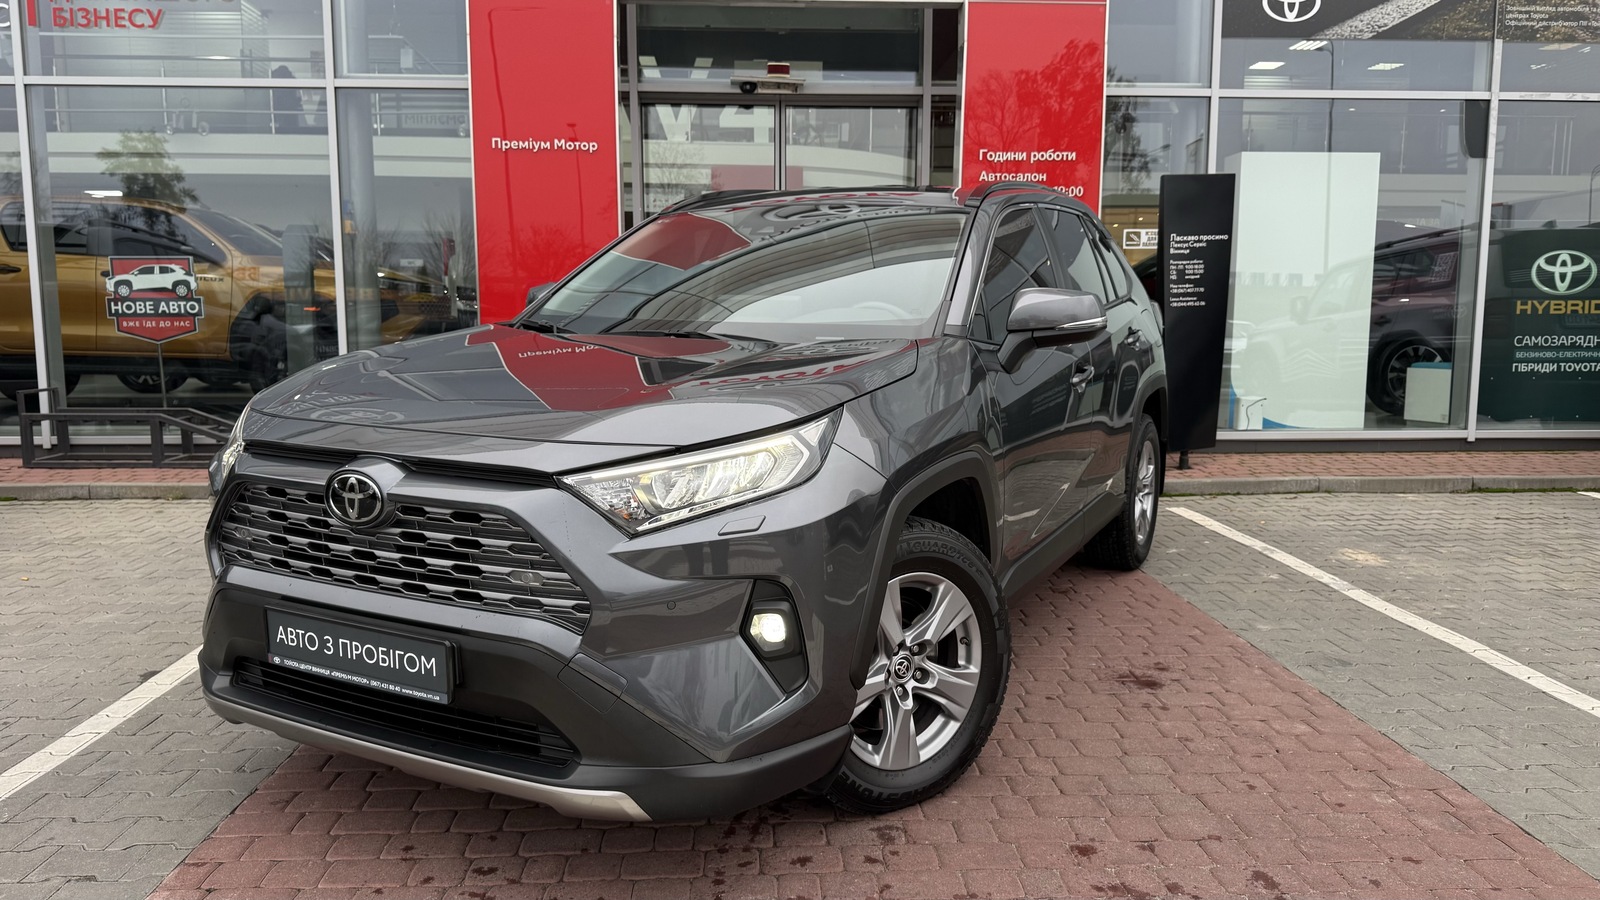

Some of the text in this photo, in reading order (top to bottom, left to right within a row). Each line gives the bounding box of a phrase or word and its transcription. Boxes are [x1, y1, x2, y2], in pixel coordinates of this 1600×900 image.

[52, 6, 162, 29] БІЗНЕСУ
[491, 137, 598, 154] Преміум Мотор
[979, 149, 1077, 164] Години роботи
[979, 171, 1047, 182] Автосалон
[1170, 233, 1229, 242] Ласкаво просимо
[1170, 241, 1189, 249] Лексус
[111, 301, 199, 314] НОВЕ АВТО
[142, 320, 157, 328] ЇДЕ
[1514, 335, 1600, 348] САМОЗАРЯДН
[1512, 363, 1557, 373] ГІБРИДИ
[276, 625, 437, 677] АВТО З ПРОБІГОМ
[370, 679, 381, 688] (067)
[401, 687, 440, 701] www.toyota.vn.ua
